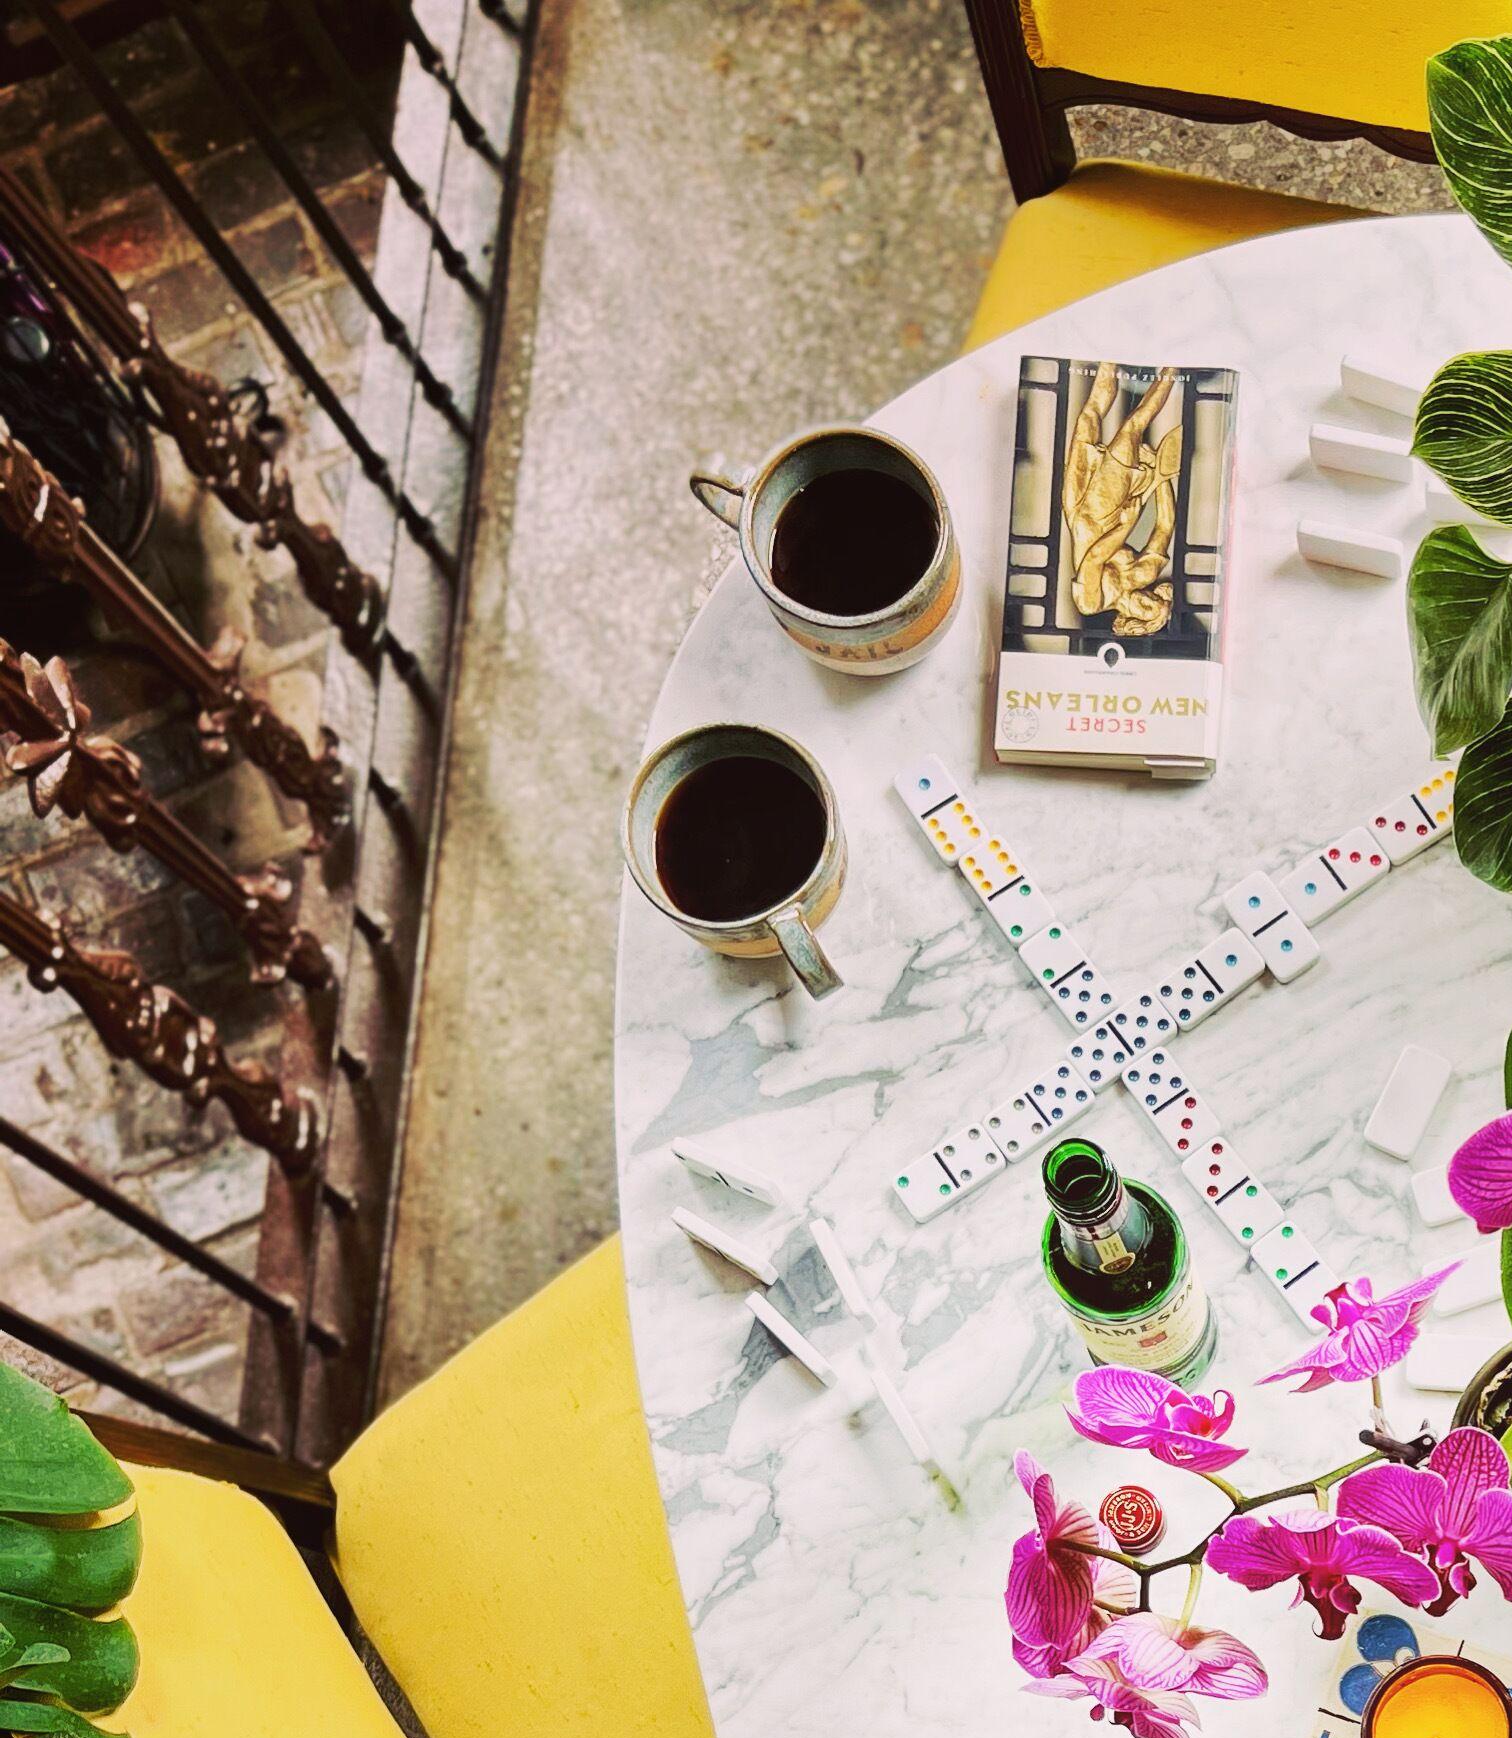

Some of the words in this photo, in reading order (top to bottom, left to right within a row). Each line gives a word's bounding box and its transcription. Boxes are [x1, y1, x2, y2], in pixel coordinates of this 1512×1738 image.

[1006, 690, 1142, 714] ORLEANS
[1150, 696, 1207, 716] NEW
[1065, 716, 1147, 734] SECRET
